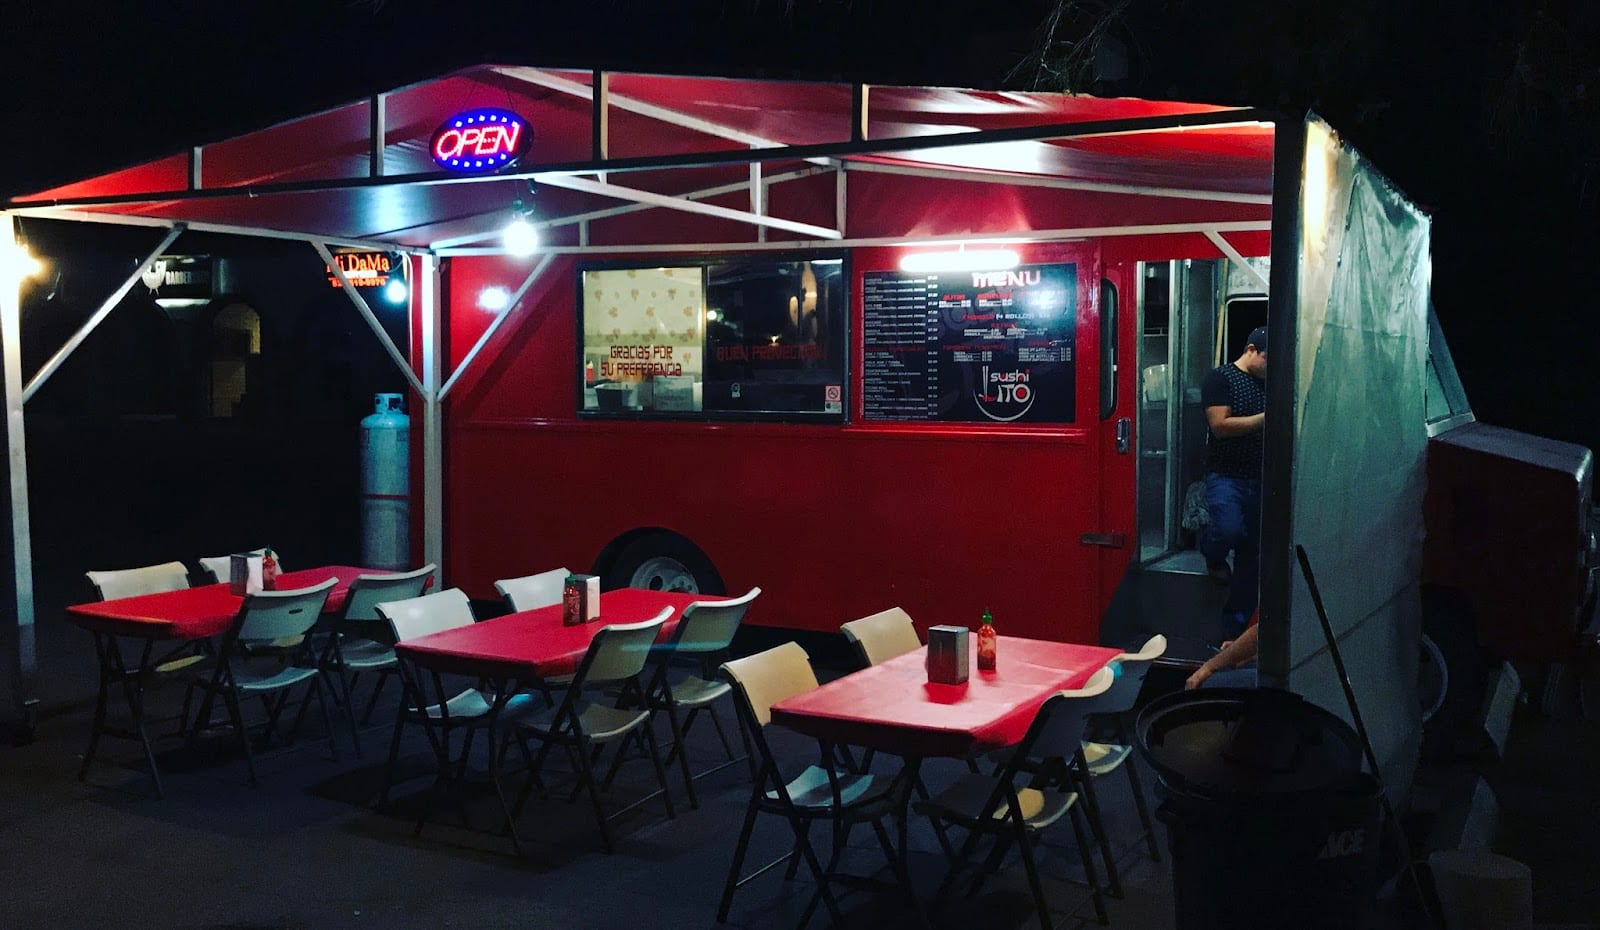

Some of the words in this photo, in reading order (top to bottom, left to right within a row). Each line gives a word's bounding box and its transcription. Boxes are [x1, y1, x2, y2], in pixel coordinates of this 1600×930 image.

[436, 123, 520, 156] OPEN
[348, 254, 390, 272] DaMa
[653, 345, 673, 359] POR
[601, 362, 614, 376] SU
[990, 370, 1031, 382] sushi
